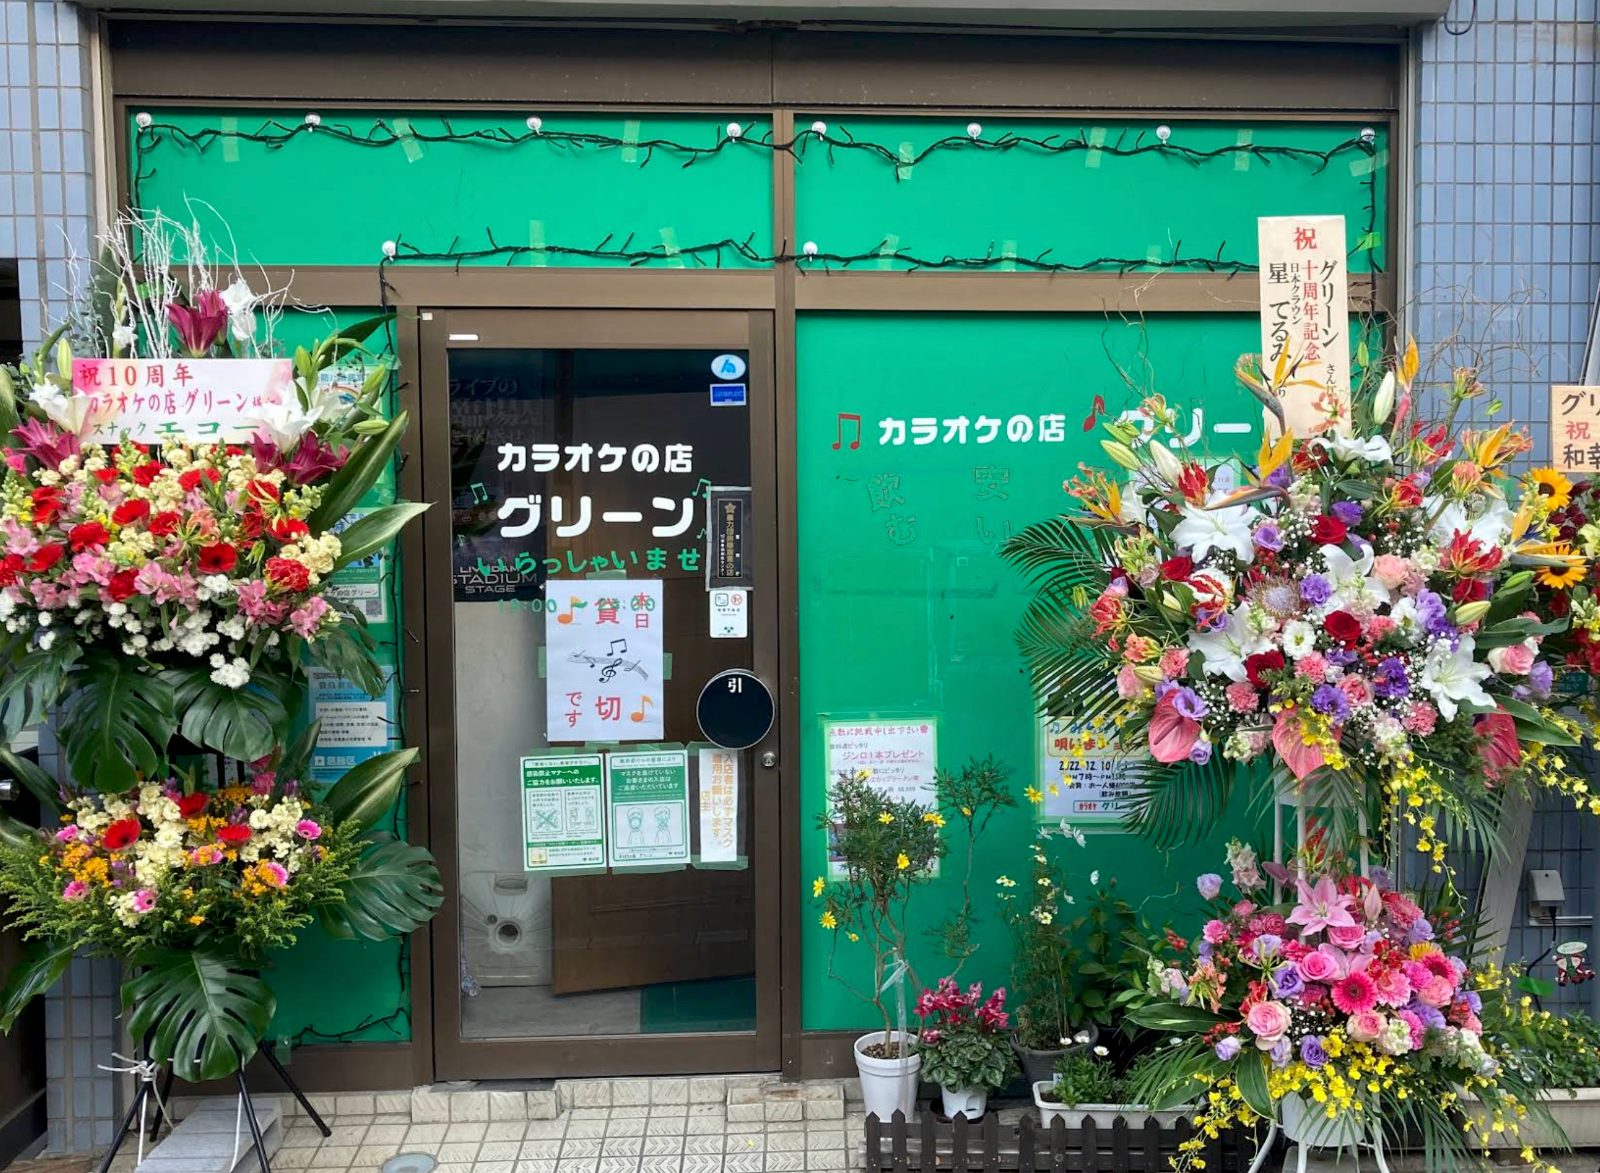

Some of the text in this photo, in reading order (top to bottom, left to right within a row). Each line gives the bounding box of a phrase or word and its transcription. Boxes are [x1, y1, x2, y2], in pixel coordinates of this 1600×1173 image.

[1293, 226, 1318, 250] 祝
[1267, 262, 1290, 285] 星
[1290, 262, 1302, 326] 日本クラウン
[1320, 259, 1339, 348] グリーン
[1301, 259, 1321, 361] 十周年記念
[154, 421, 260, 435] エコー
[878, 413, 1067, 446] カラオケの店
[1114, 407, 1264, 449] グリー
[1566, 420, 1591, 440] 祝
[496, 442, 694, 473] カラオケの店
[496, 494, 695, 538] グリーン
[464, 585, 517, 595] STAGE
[728, 677, 743, 693] 引
[564, 692, 583, 728] です
[595, 695, 622, 721] 切
